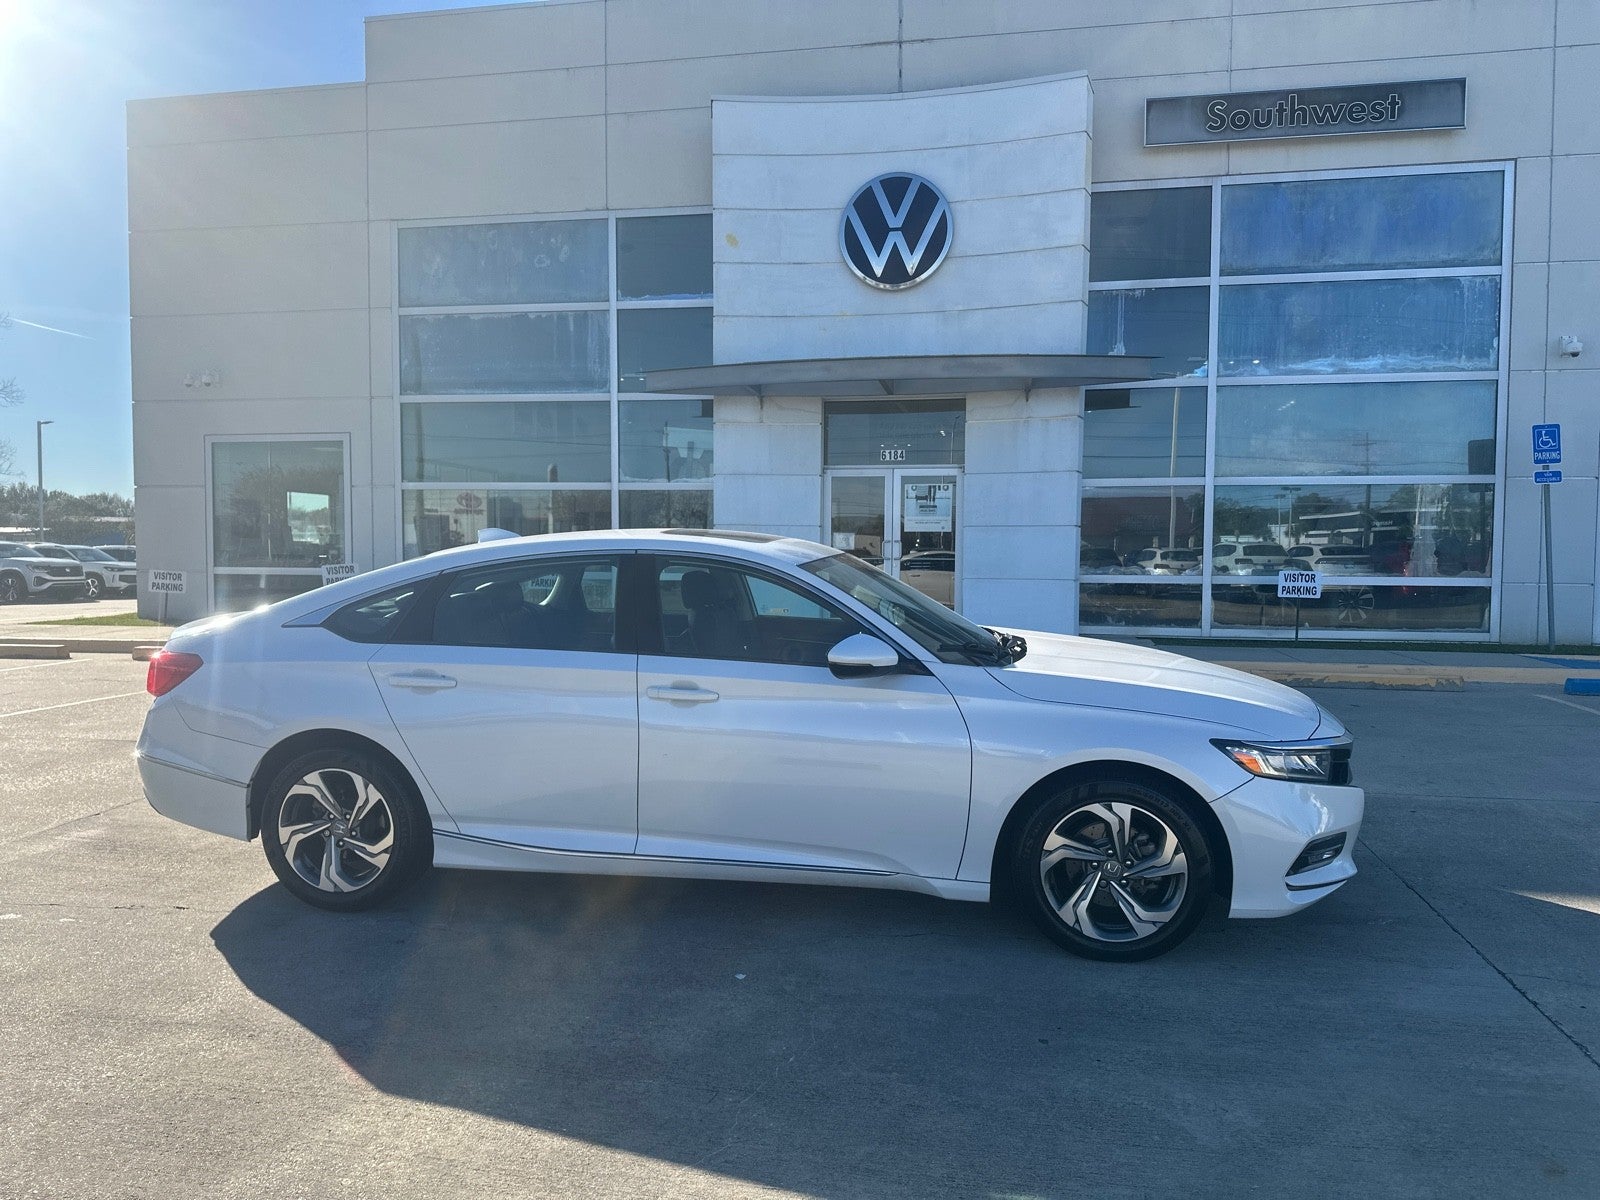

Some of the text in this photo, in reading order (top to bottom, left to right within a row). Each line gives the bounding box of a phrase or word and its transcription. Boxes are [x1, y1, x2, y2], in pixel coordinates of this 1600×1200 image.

[1205, 93, 1402, 133] Southwest
[881, 450, 905, 460] 6184
[1534, 451, 1560, 461] PARKING
[326, 565, 355, 575] VISITOR
[153, 572, 182, 581] VISITOR
[1283, 573, 1316, 583] VISITOR
[151, 582, 183, 591] PARKING
[1281, 585, 1317, 596] PARKING
